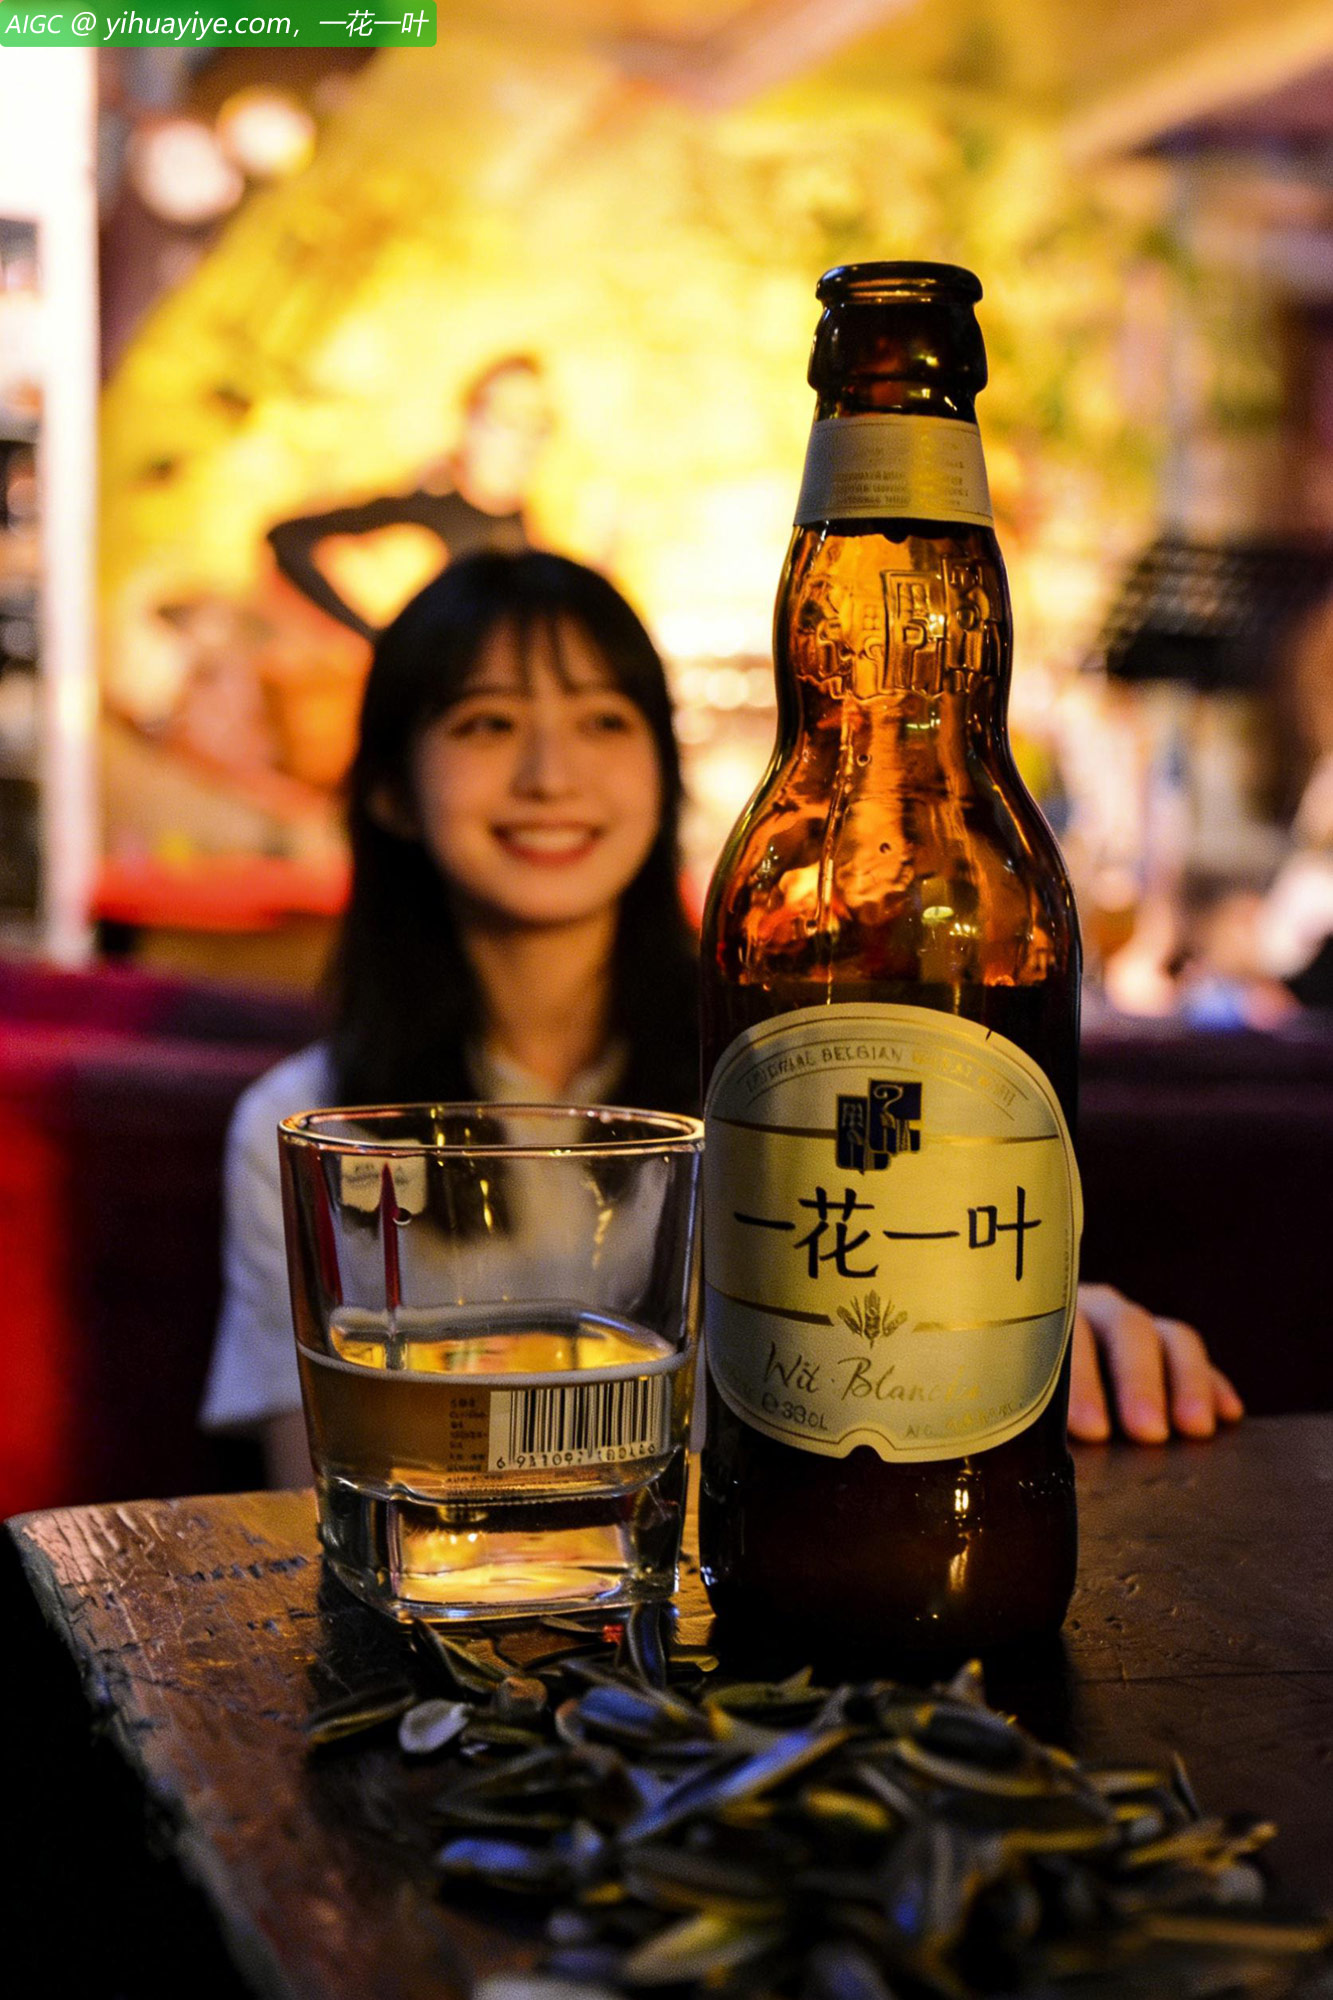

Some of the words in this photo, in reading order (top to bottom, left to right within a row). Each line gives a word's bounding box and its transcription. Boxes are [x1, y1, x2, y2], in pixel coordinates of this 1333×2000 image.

[733, 1185, 1043, 1282] 一花一叶
[837, 1356, 981, 1402] Blanc
